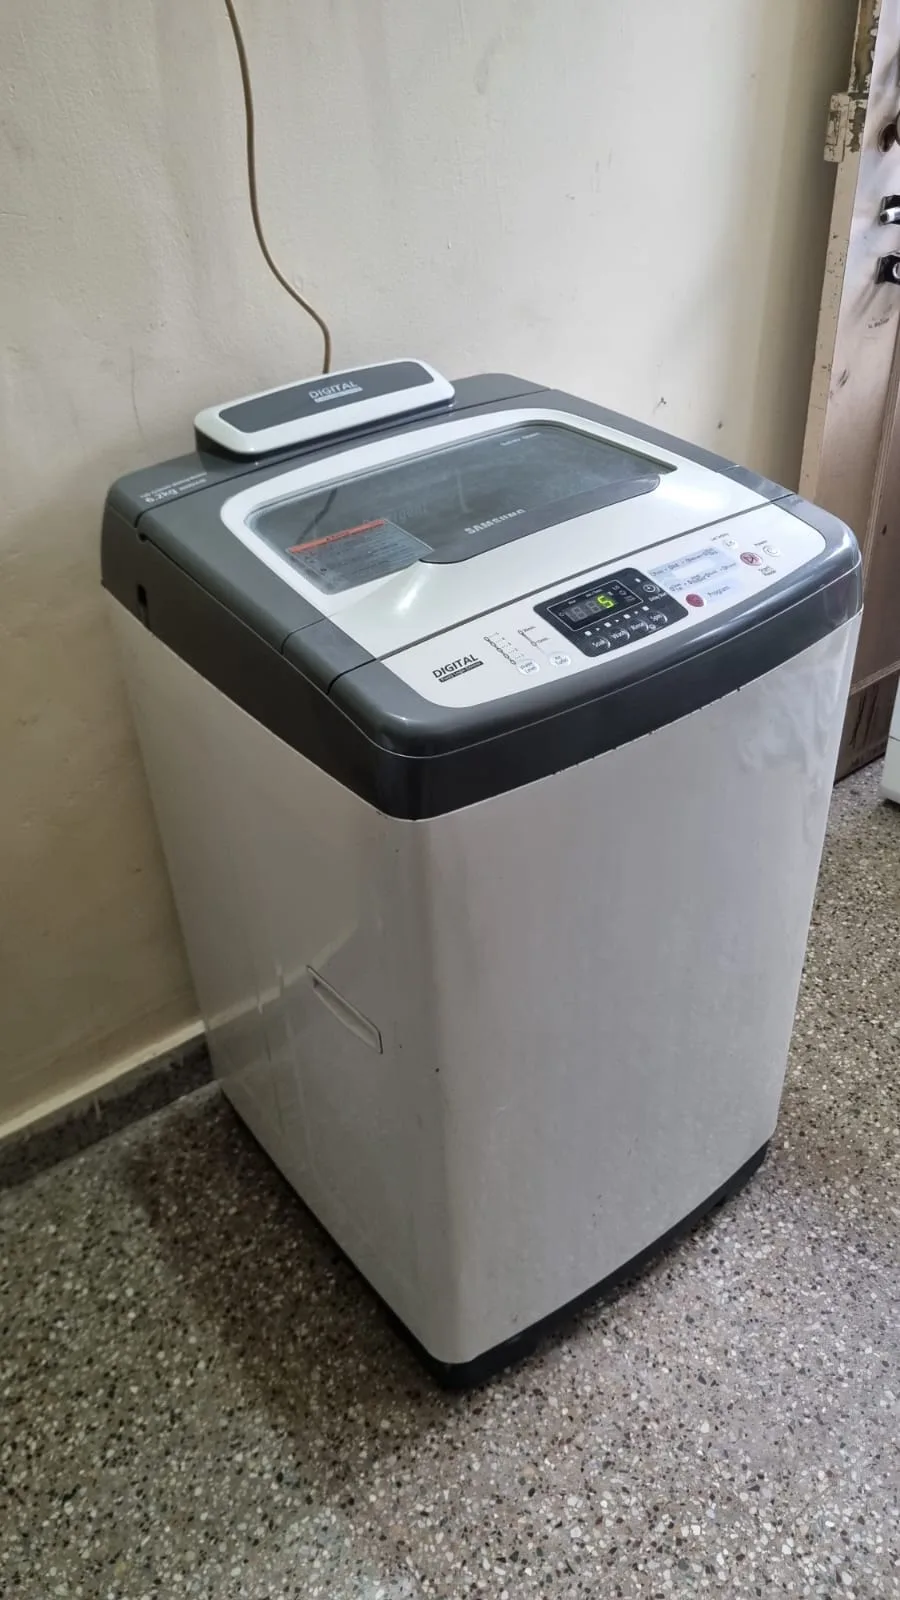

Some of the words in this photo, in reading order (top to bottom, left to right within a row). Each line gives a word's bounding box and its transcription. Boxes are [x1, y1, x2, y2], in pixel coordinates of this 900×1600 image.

[308, 381, 358, 399] DIGITAL
[597, 595, 614, 609] 5
[432, 654, 479, 678] DIGITAL
